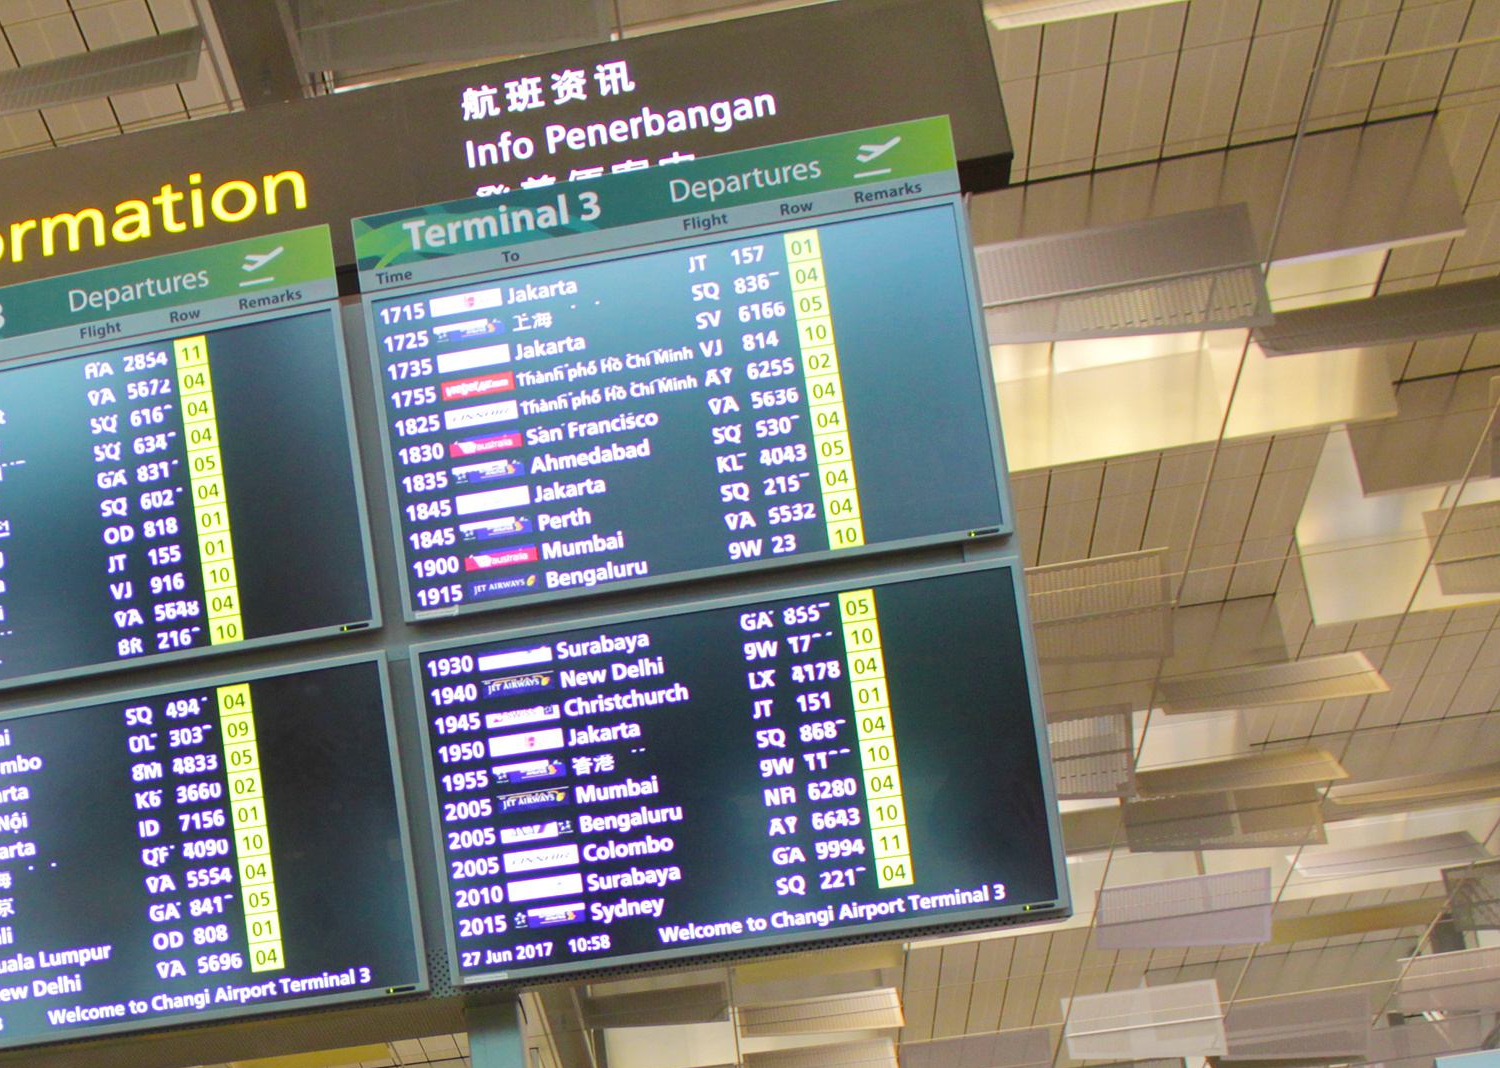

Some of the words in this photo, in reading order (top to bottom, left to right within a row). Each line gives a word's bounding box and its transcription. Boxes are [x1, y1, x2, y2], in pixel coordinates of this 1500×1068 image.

[462, 60, 635, 121] 航班资讯
[467, 132, 533, 167] Info
[546, 93, 776, 153] Penerbangan
[402, 193, 569, 250] Terminal
[578, 191, 601, 220] 3
[669, 159, 821, 202] Departures
[375, 271, 412, 284] Time
[501, 250, 520, 262] To
[683, 213, 728, 230] Flight
[779, 202, 812, 216] Row
[853, 182, 922, 203] Remarks
[68, 270, 209, 312] Departures
[380, 302, 425, 324] 1715
[507, 280, 578, 304] Jakarta
[79, 322, 121, 339] Flight
[169, 309, 200, 323] Row
[238, 289, 302, 310] Remarks
[530, 437, 650, 474] Ahmedabad
[103, 525, 134, 544] OD
[143, 517, 178, 538] 818
[537, 507, 591, 531] Perth
[541, 530, 624, 560] Mumbai
[150, 572, 184, 593] 916
[417, 584, 463, 606] 1915
[545, 560, 648, 588] Bengaluru
[728, 539, 761, 559] 9W
[771, 534, 796, 553] 23
[427, 655, 473, 677] 1930
[556, 633, 649, 659] Surabaya
[560, 668, 607, 688] New
[611, 656, 664, 680] Delhi
[563, 682, 688, 716] Christchurch
[575, 775, 658, 803] Mumbai
[579, 806, 683, 833] Bengaluru
[583, 835, 674, 861] Colombo
[459, 914, 507, 937] 2015
[590, 898, 664, 923] Sydney
[38, 945, 111, 968] Lumpur
[32, 973, 82, 997] Delhi
